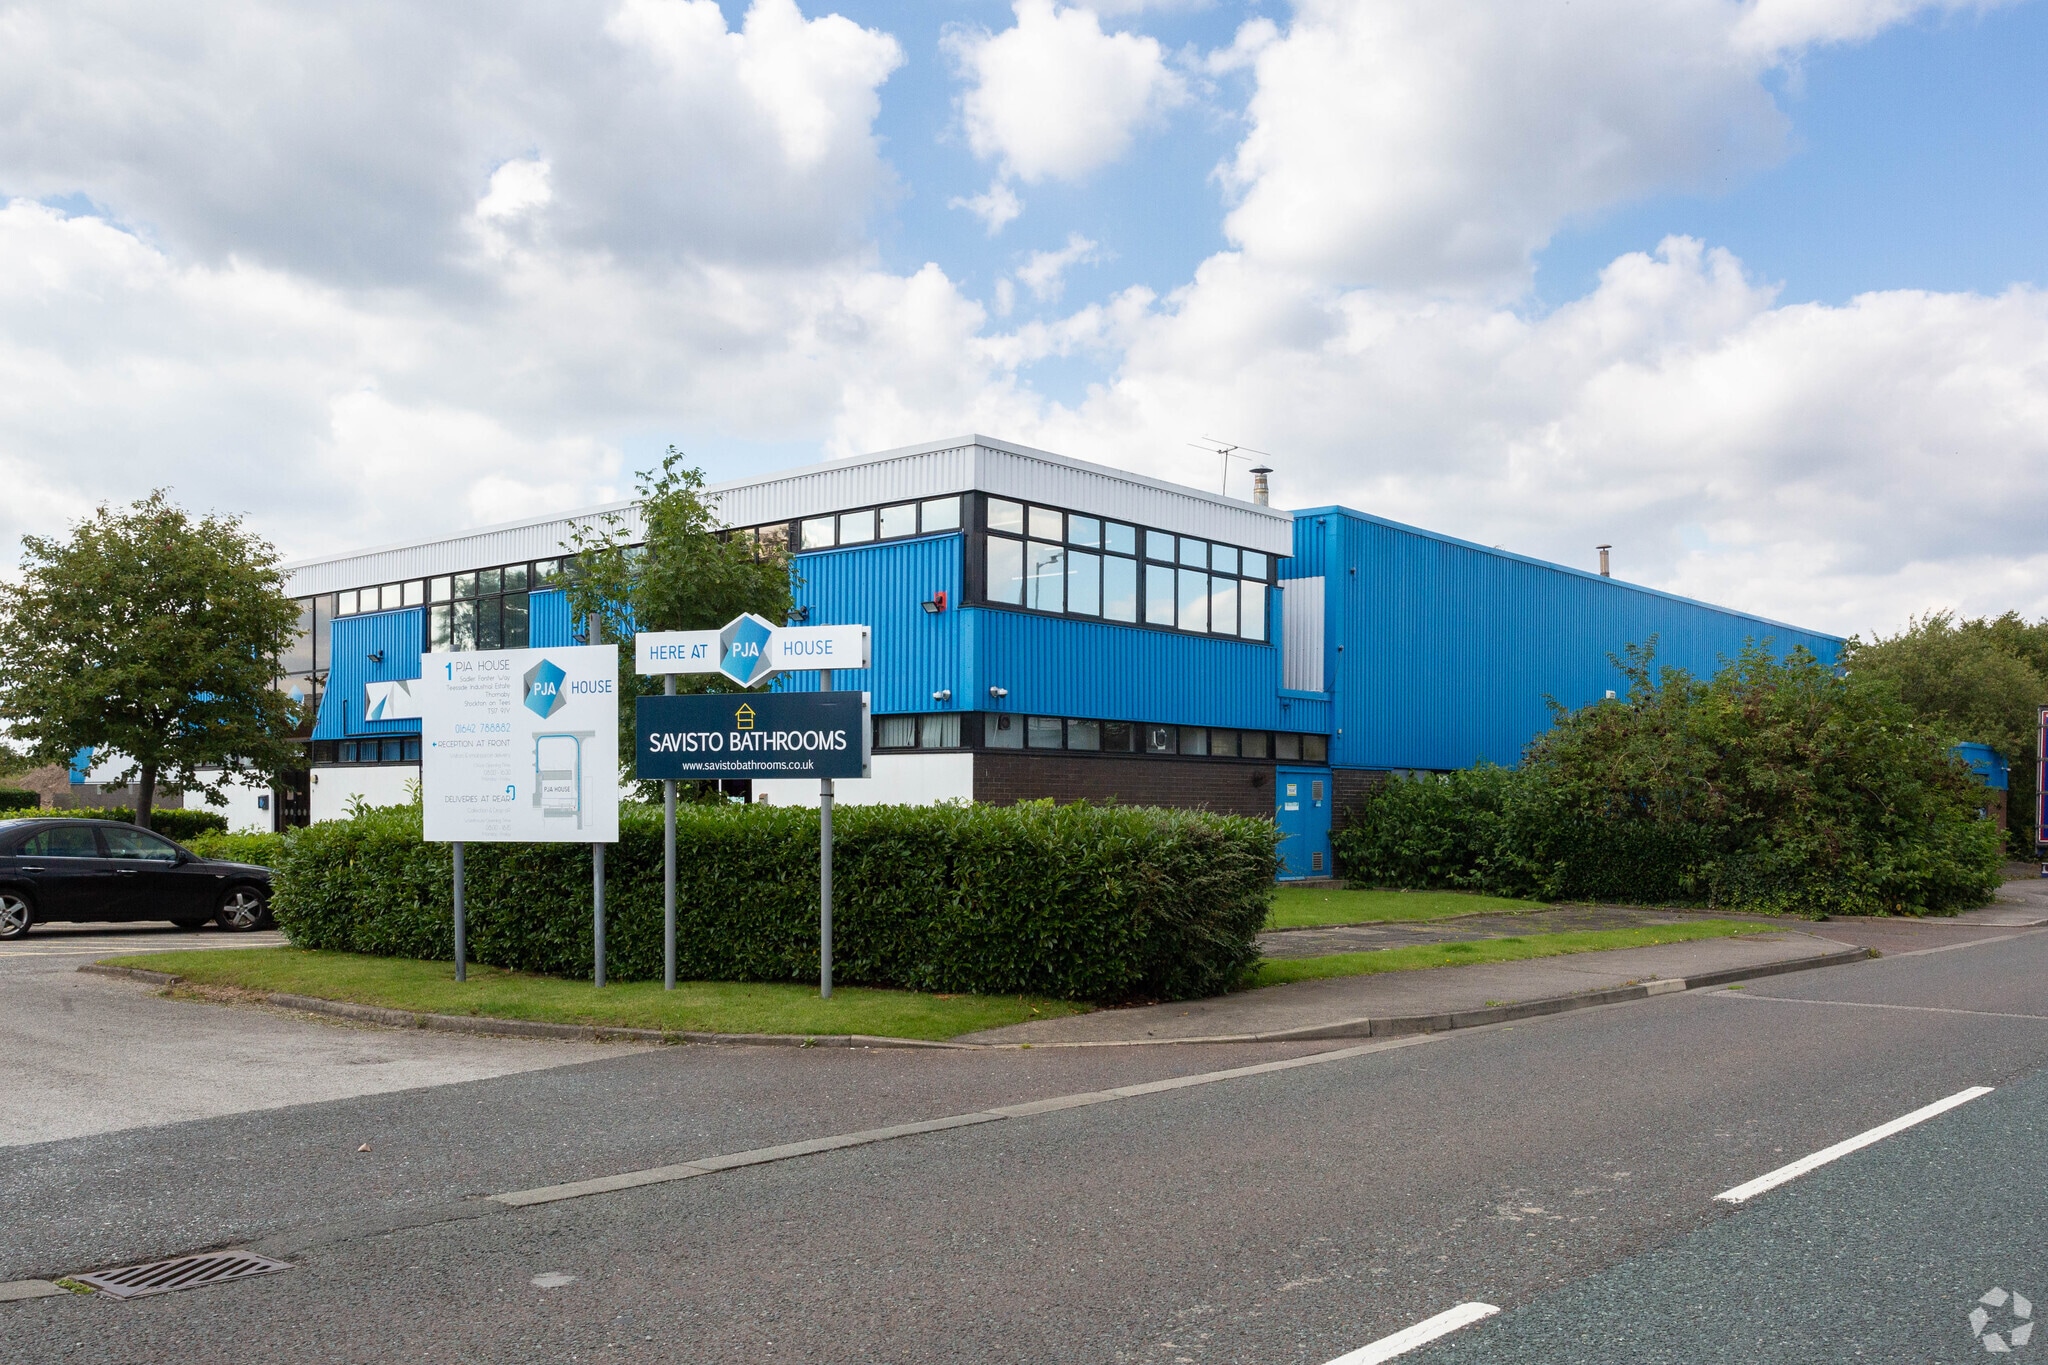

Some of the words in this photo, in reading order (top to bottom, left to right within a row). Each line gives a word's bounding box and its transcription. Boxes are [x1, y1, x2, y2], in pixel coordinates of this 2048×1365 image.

[650, 645, 686, 660] HERE
[691, 644, 708, 659] AT
[732, 642, 759, 657] PJA
[784, 640, 833, 656] HOUSE
[456, 661, 473, 671] PJA
[478, 659, 510, 671] HOUSE
[445, 662, 452, 681] 1
[534, 682, 556, 696] PJA
[571, 680, 612, 694] HOUSE
[455, 724, 476, 734] 01642
[438, 740, 473, 748] RECEPTION
[476, 739, 485, 747] AT
[488, 739, 510, 747] FRONT
[650, 732, 723, 752] SAVISTO
[730, 730, 847, 751] BATHROOMS
[682, 759, 814, 771] www.savistobathrooms.co.uk
[444, 795, 478, 803] DELIVERIES
